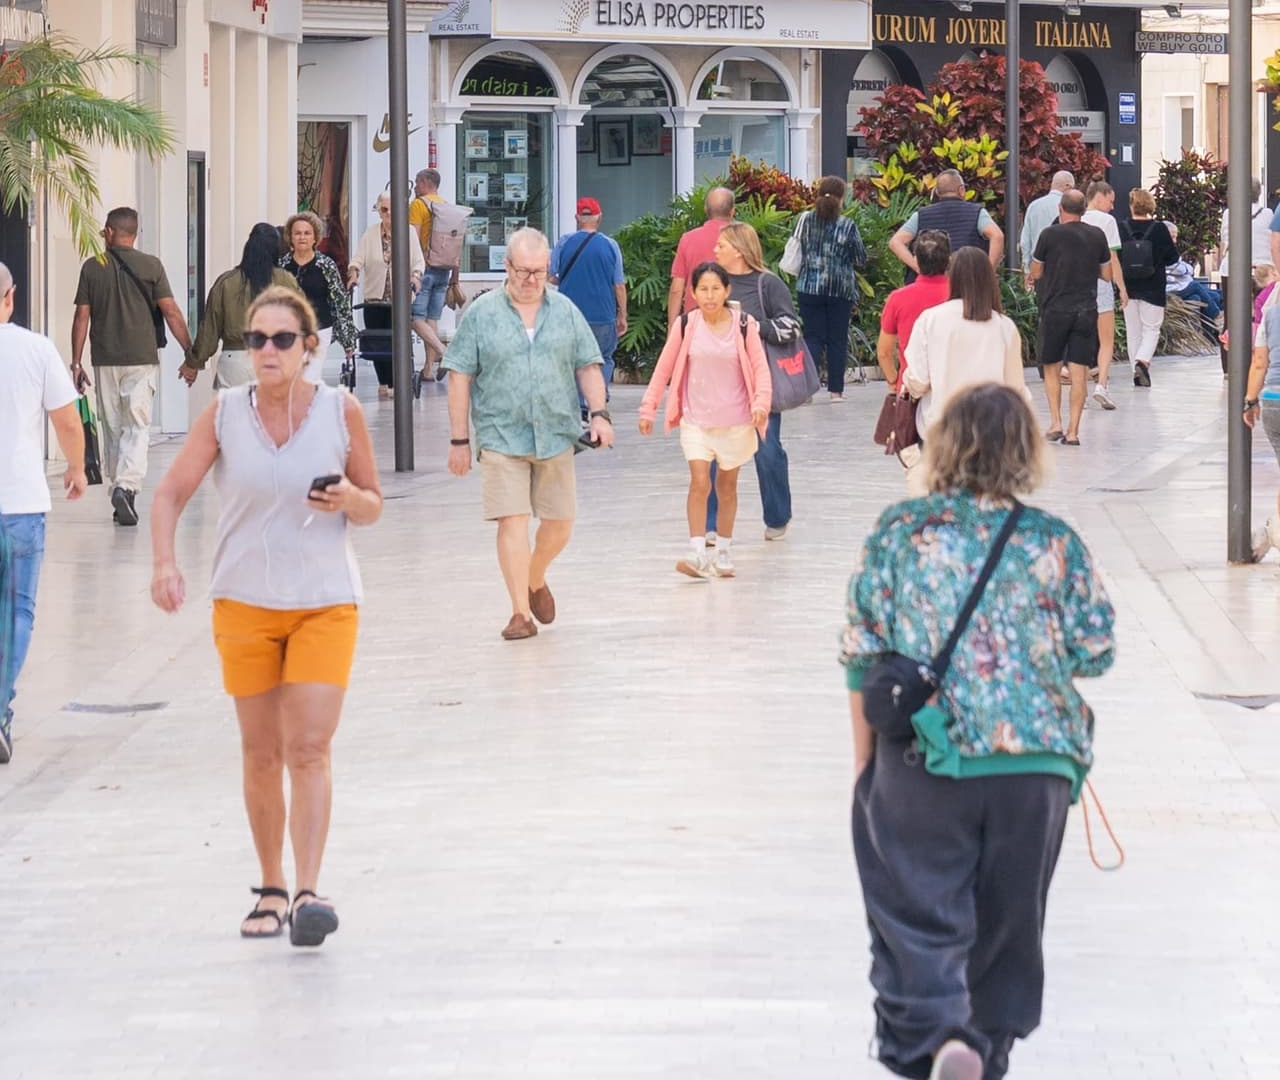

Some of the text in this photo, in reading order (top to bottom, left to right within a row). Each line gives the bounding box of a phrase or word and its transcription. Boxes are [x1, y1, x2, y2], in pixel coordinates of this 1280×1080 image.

[597, 0, 765, 30] ELISA PROPERTIES
[779, 29, 819, 39] REAL ESTATE
[872, 14, 1111, 48] URUM JOYERI ITALIANA
[1138, 33, 1222, 43] COMPRO ORO
[1138, 42, 1223, 52] WE BUY GOLD
[1070, 117, 1089, 128] SHOP
